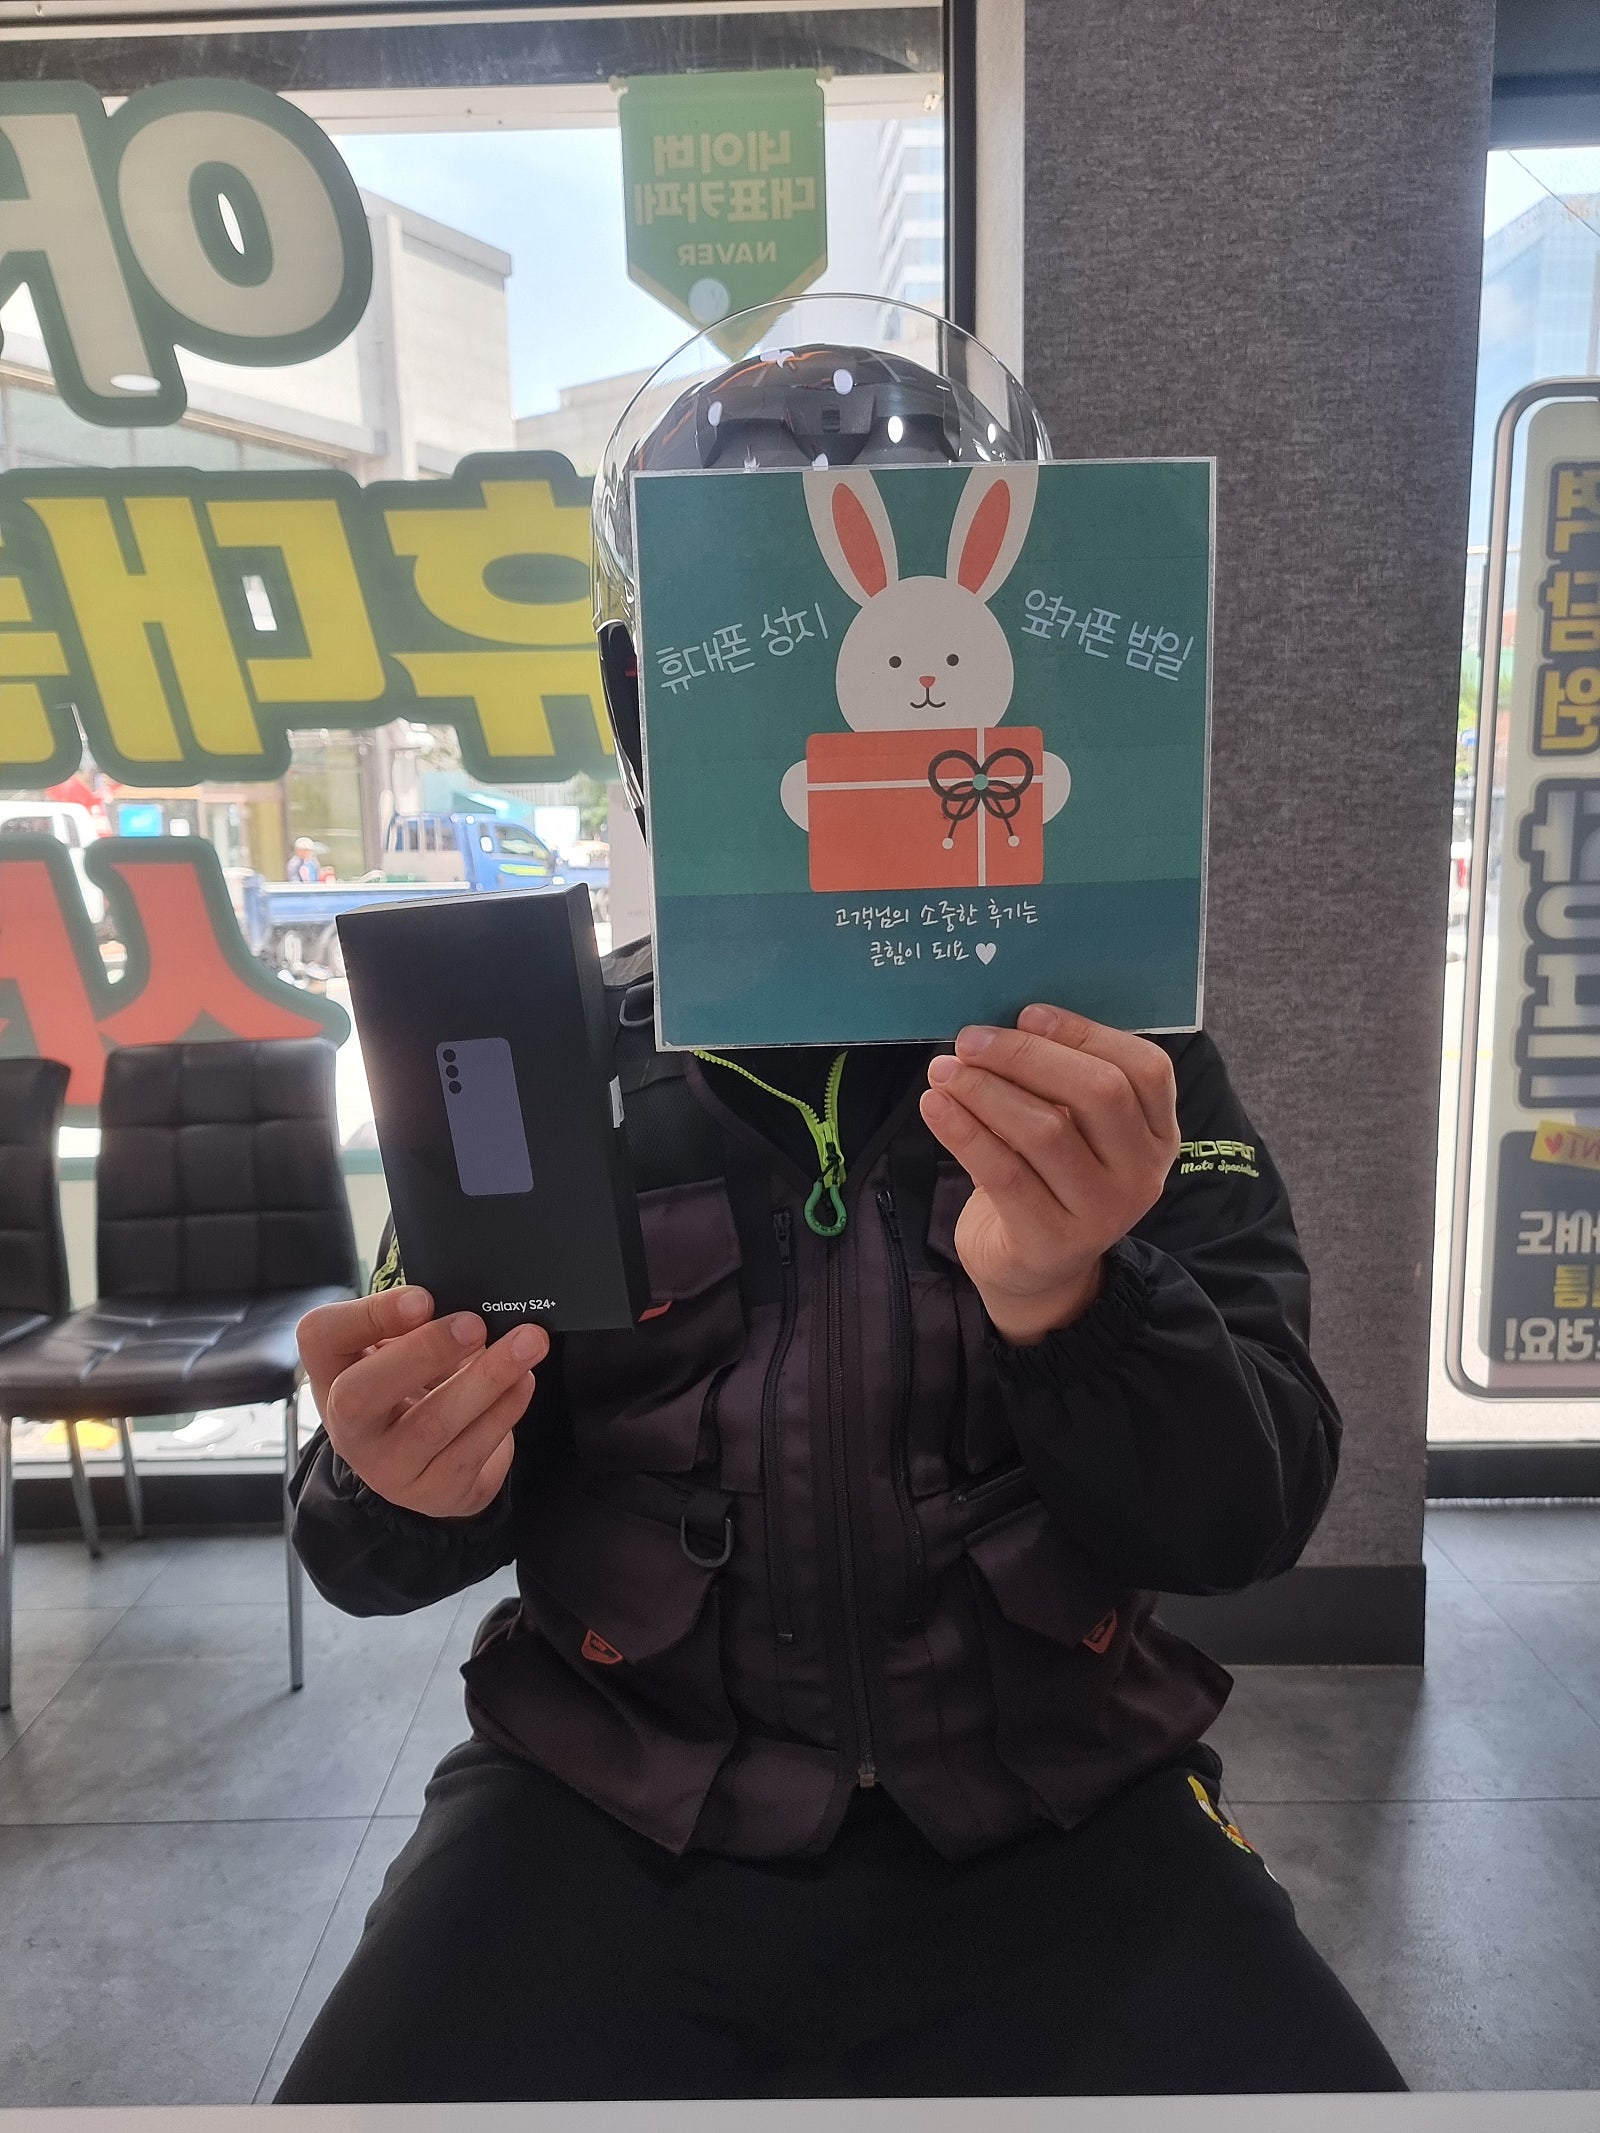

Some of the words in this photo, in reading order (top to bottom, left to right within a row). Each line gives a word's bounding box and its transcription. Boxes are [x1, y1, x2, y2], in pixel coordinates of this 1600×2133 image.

[655, 623, 755, 695] 휴대폰
[760, 602, 829, 656] 성지
[1020, 589, 1121, 659] 옆카폰
[1125, 621, 1194, 681] 범일
[835, 906, 909, 931] 고객님의
[920, 900, 978, 933] 소중한
[988, 898, 1039, 929] 후기는
[869, 940, 921, 967] 큰힘이
[931, 939, 970, 961] 되요
[1180, 1160, 1214, 1174] Moto
[481, 1301, 527, 1314] Galaxy
[528, 1298, 556, 1310] S24+
